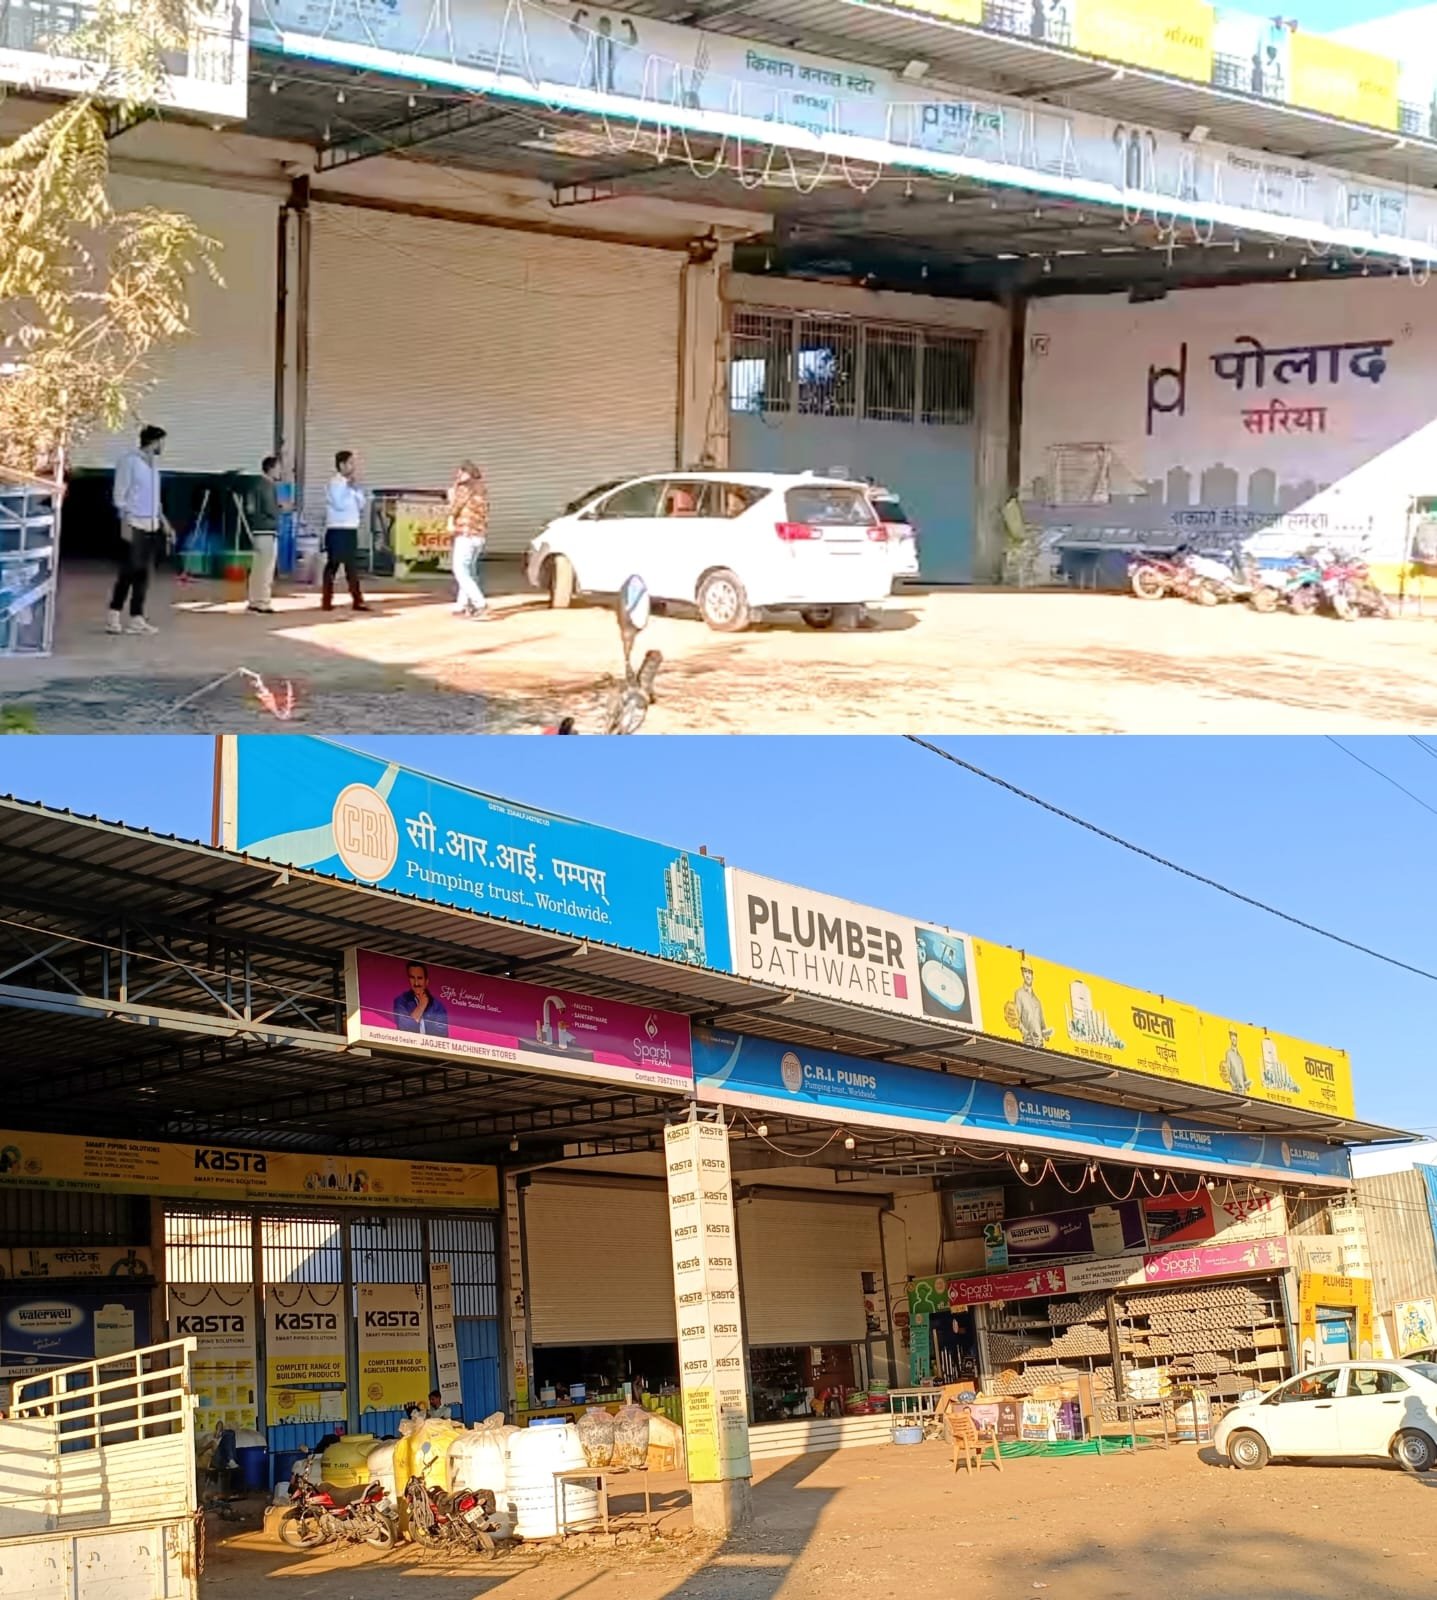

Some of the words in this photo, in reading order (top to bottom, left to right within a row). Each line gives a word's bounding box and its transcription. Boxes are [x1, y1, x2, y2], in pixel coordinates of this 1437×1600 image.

[746, 49, 794, 80] किसान
[798, 65, 842, 88] जनरल
[846, 71, 877, 96] स्टोर
[1209, 335, 1394, 390] पोलाद
[1240, 398, 1327, 434] सरिया
[343, 803, 388, 861] CRI
[406, 860, 485, 898] Pumping
[535, 892, 613, 926] Worldwide.
[552, 858, 611, 906] पम्पस्
[748, 894, 905, 969] PLUMBER
[751, 941, 892, 997] BATHWARE
[1131, 1006, 1176, 1039] कास्ता
[369, 1031, 399, 1042] Authorised
[420, 1037, 451, 1050] JAGJEET
[451, 1042, 490, 1057] MACHINERY
[491, 1049, 517, 1060] STORES
[633, 1037, 672, 1065] Sparsh
[804, 1063, 835, 1082] C.R.I.
[837, 1069, 877, 1089] PUMPS
[1303, 1056, 1335, 1082] कास्ता
[804, 1080, 832, 1093] Pumping
[1042, 1103, 1071, 1121] PUMPS
[85, 1141, 106, 1149] SMART
[128, 1144, 161, 1153] SOLUTIONS
[1190, 1131, 1212, 1145] PUMPS
[1010, 1224, 1050, 1239] waterwell
[1161, 1252, 1201, 1276] Sparsh
[960, 1278, 993, 1301] Sparsh
[1323, 1275, 1353, 1289] PLUMBER
[19, 1308, 72, 1321] waterwell
[275, 1363, 309, 1372] COMPLETE
[310, 1362, 331, 1371] RANGE
[332, 1362, 341, 1370] OF
[363, 1366, 402, 1375] AGRICULTURE
[368, 1359, 395, 1367] COMPLETE
[396, 1358, 415, 1366] RANGE
[415, 1358, 422, 1366] OF
[276, 1372, 307, 1381] BUILDING
[308, 1371, 341, 1380] PRODUCTS
